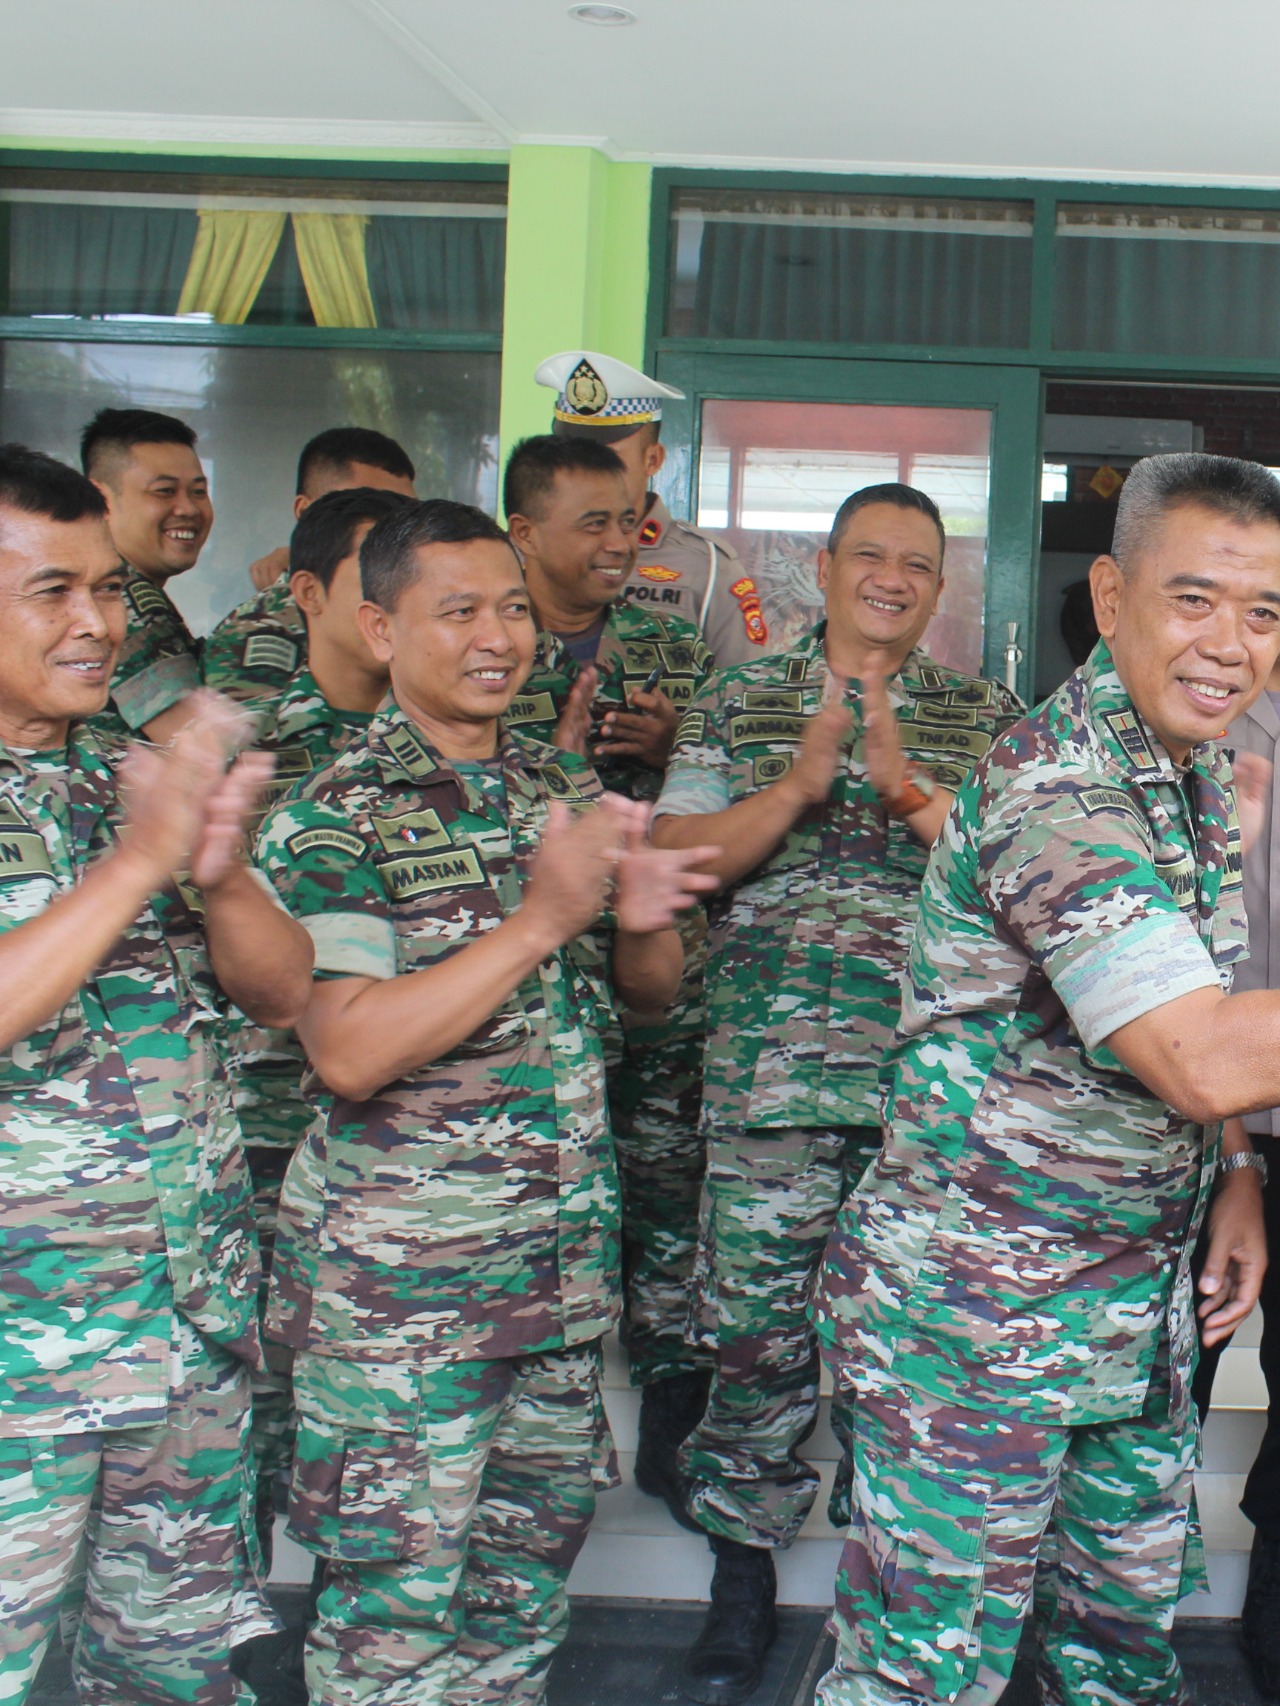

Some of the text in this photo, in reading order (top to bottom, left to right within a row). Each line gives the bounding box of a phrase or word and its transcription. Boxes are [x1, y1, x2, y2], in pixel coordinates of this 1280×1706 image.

[624, 585, 681, 605] POLRI
[917, 731, 970, 747] TNI AD
[392, 859, 471, 890] MASTAM
